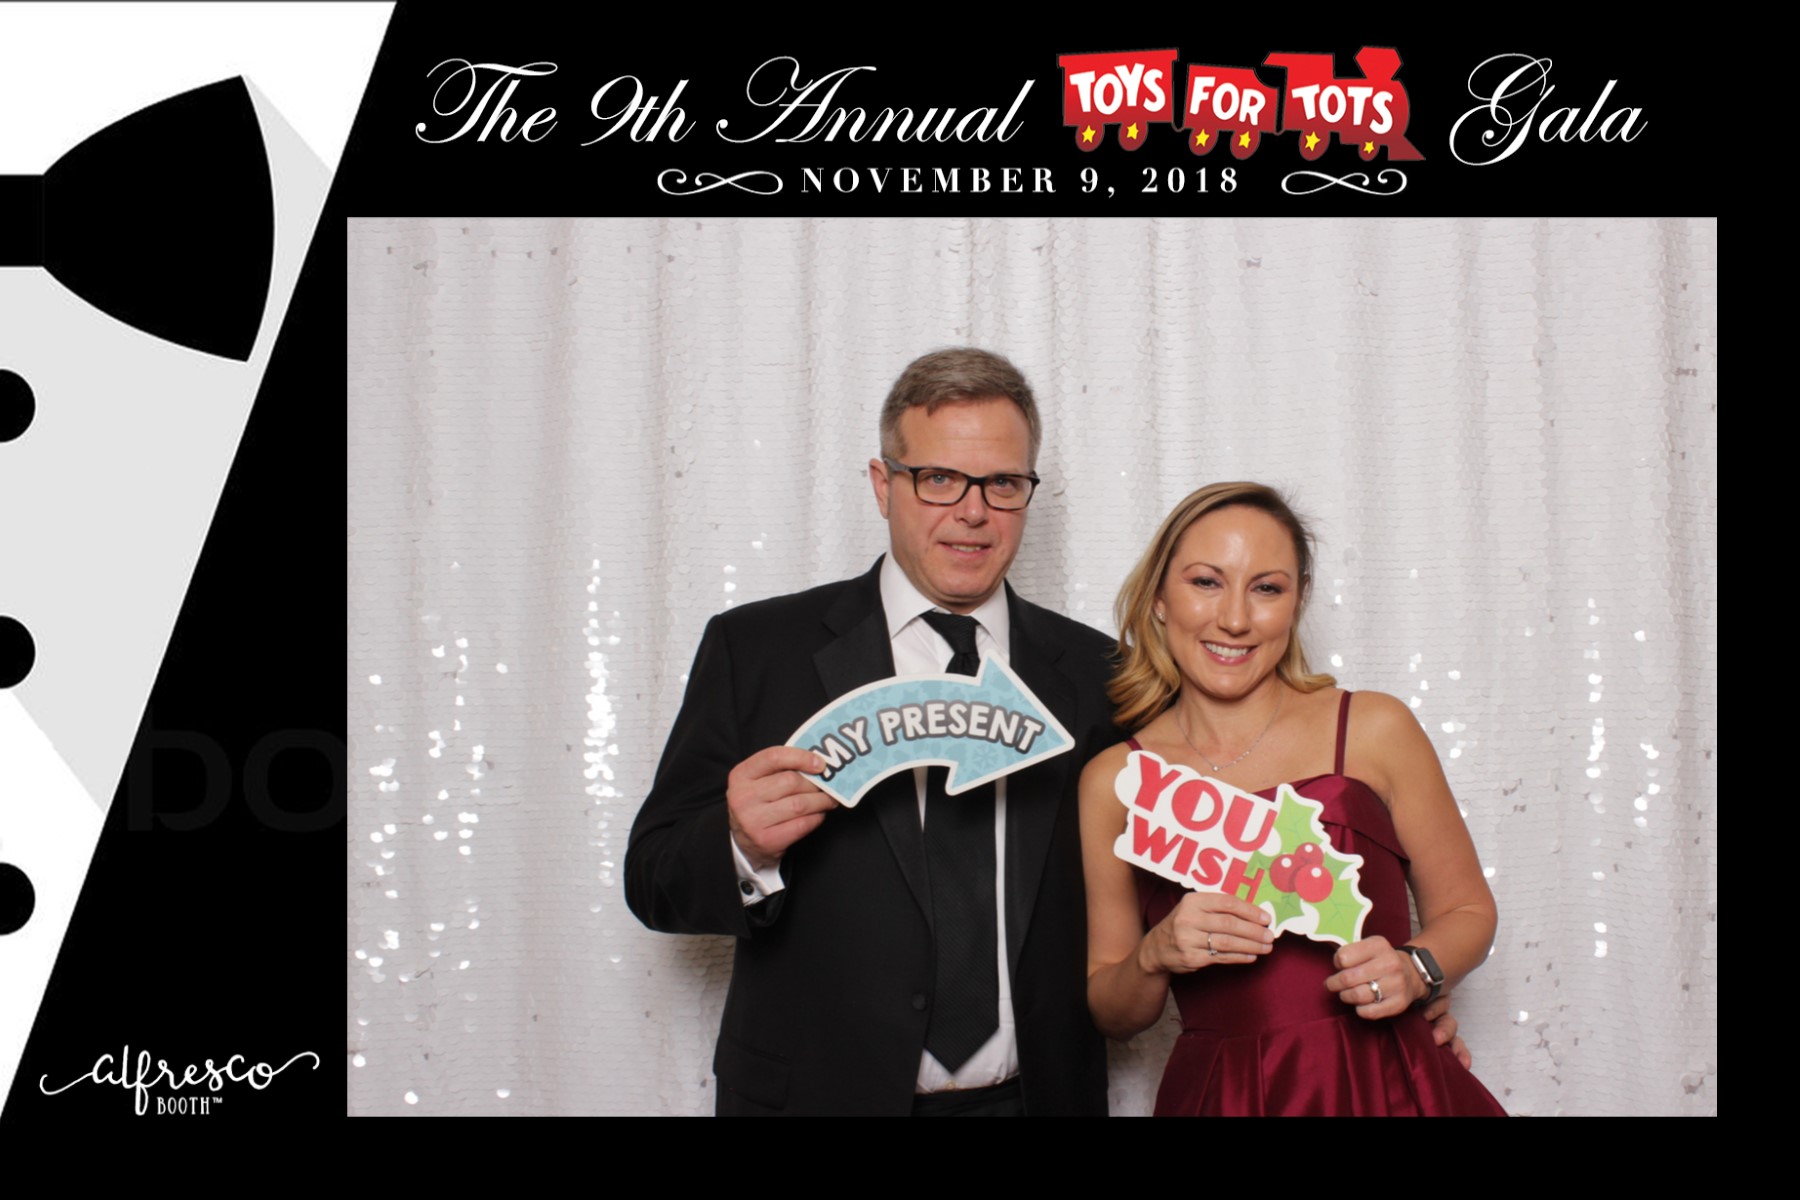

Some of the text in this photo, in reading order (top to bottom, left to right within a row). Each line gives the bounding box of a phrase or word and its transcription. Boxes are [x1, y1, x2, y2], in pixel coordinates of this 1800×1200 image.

[808, 699, 1046, 781] MY PRESENT
[1134, 753, 1278, 852] YOU
[1132, 814, 1265, 904] WISH
